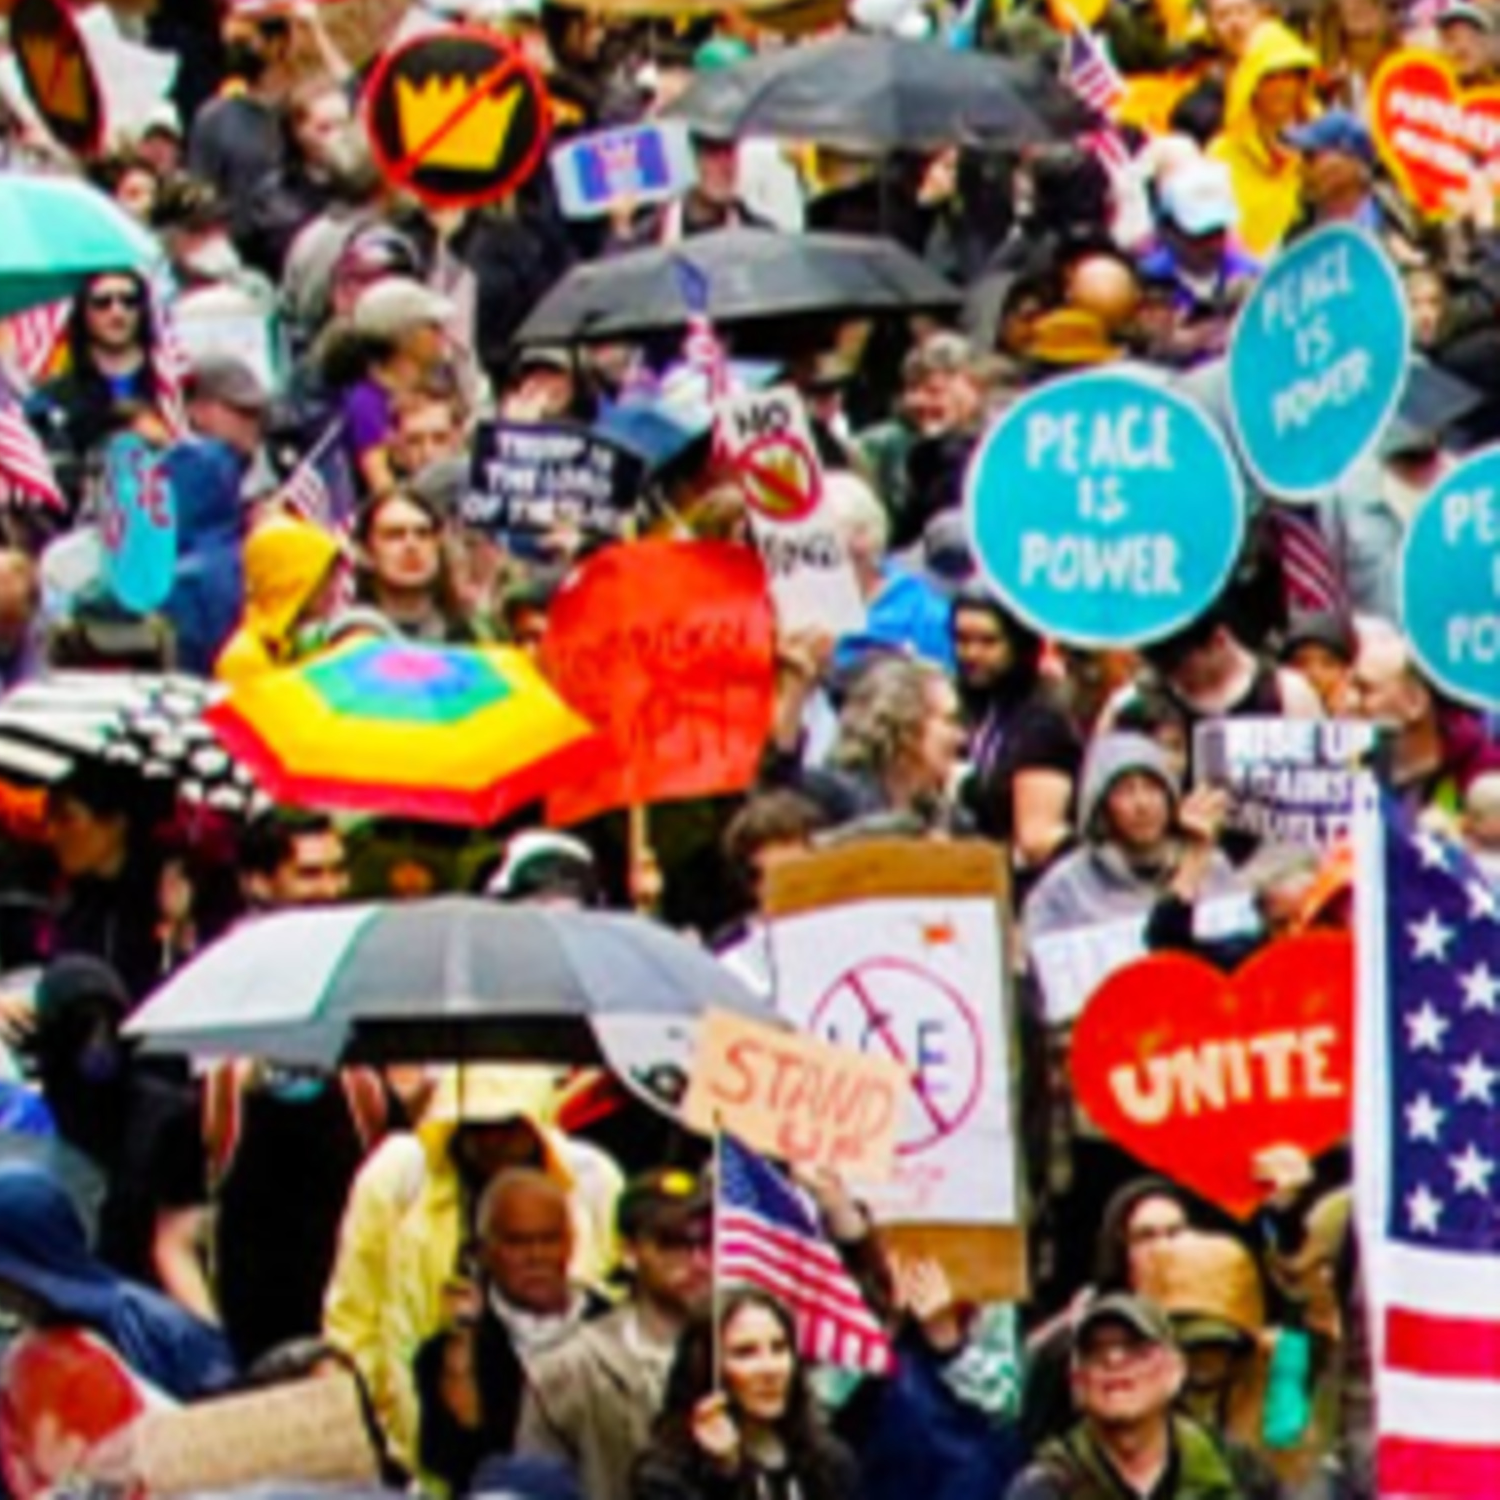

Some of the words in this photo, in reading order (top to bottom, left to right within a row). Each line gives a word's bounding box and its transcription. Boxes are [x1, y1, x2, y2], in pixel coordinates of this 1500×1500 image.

[1263, 245, 1354, 331] PEACE
[1297, 322, 1334, 364] IS
[1270, 349, 1372, 438] POWER
[1025, 405, 1174, 477] PEACE
[1077, 477, 1128, 523] IS
[1018, 534, 1183, 596] POWER
[708, 1038, 896, 1141] STAND
[1111, 1027, 1342, 1124] UNITE
